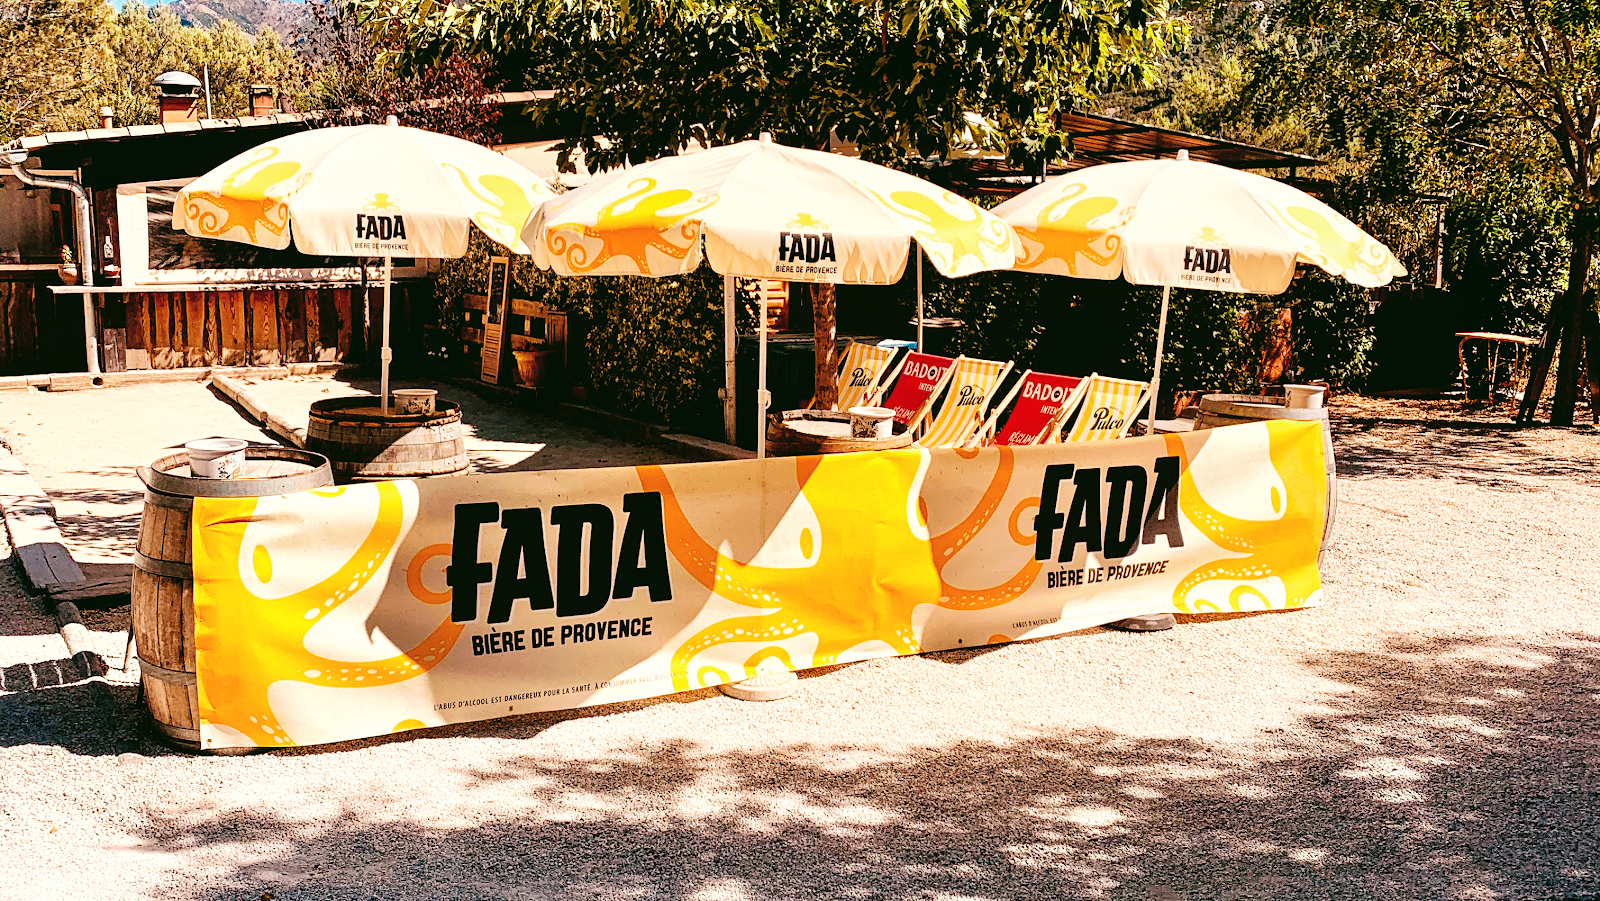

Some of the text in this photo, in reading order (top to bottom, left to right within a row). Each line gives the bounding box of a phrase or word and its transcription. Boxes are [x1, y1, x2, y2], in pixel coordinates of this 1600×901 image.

[355, 213, 407, 240] FADA
[779, 231, 836, 263] FADA
[1183, 245, 1231, 274] FADA
[795, 265, 804, 273] DE
[805, 266, 838, 274] PROVENCE
[956, 385, 984, 407] Pulco
[1089, 406, 1125, 431] Pulco
[1033, 455, 1185, 563] FADA
[446, 491, 673, 625] FADA
[1047, 560, 1169, 589] BIÈRE DE PROVENCE
[471, 616, 653, 656] BIÈRE DE PROVENCE
[433, 701, 456, 711] L'ABUS
[458, 698, 489, 708] D'ALCOOL
[491, 696, 502, 704] EST
[504, 691, 542, 702] DANGEREUX
[543, 688, 560, 697] POUR
[562, 686, 570, 695] LA
